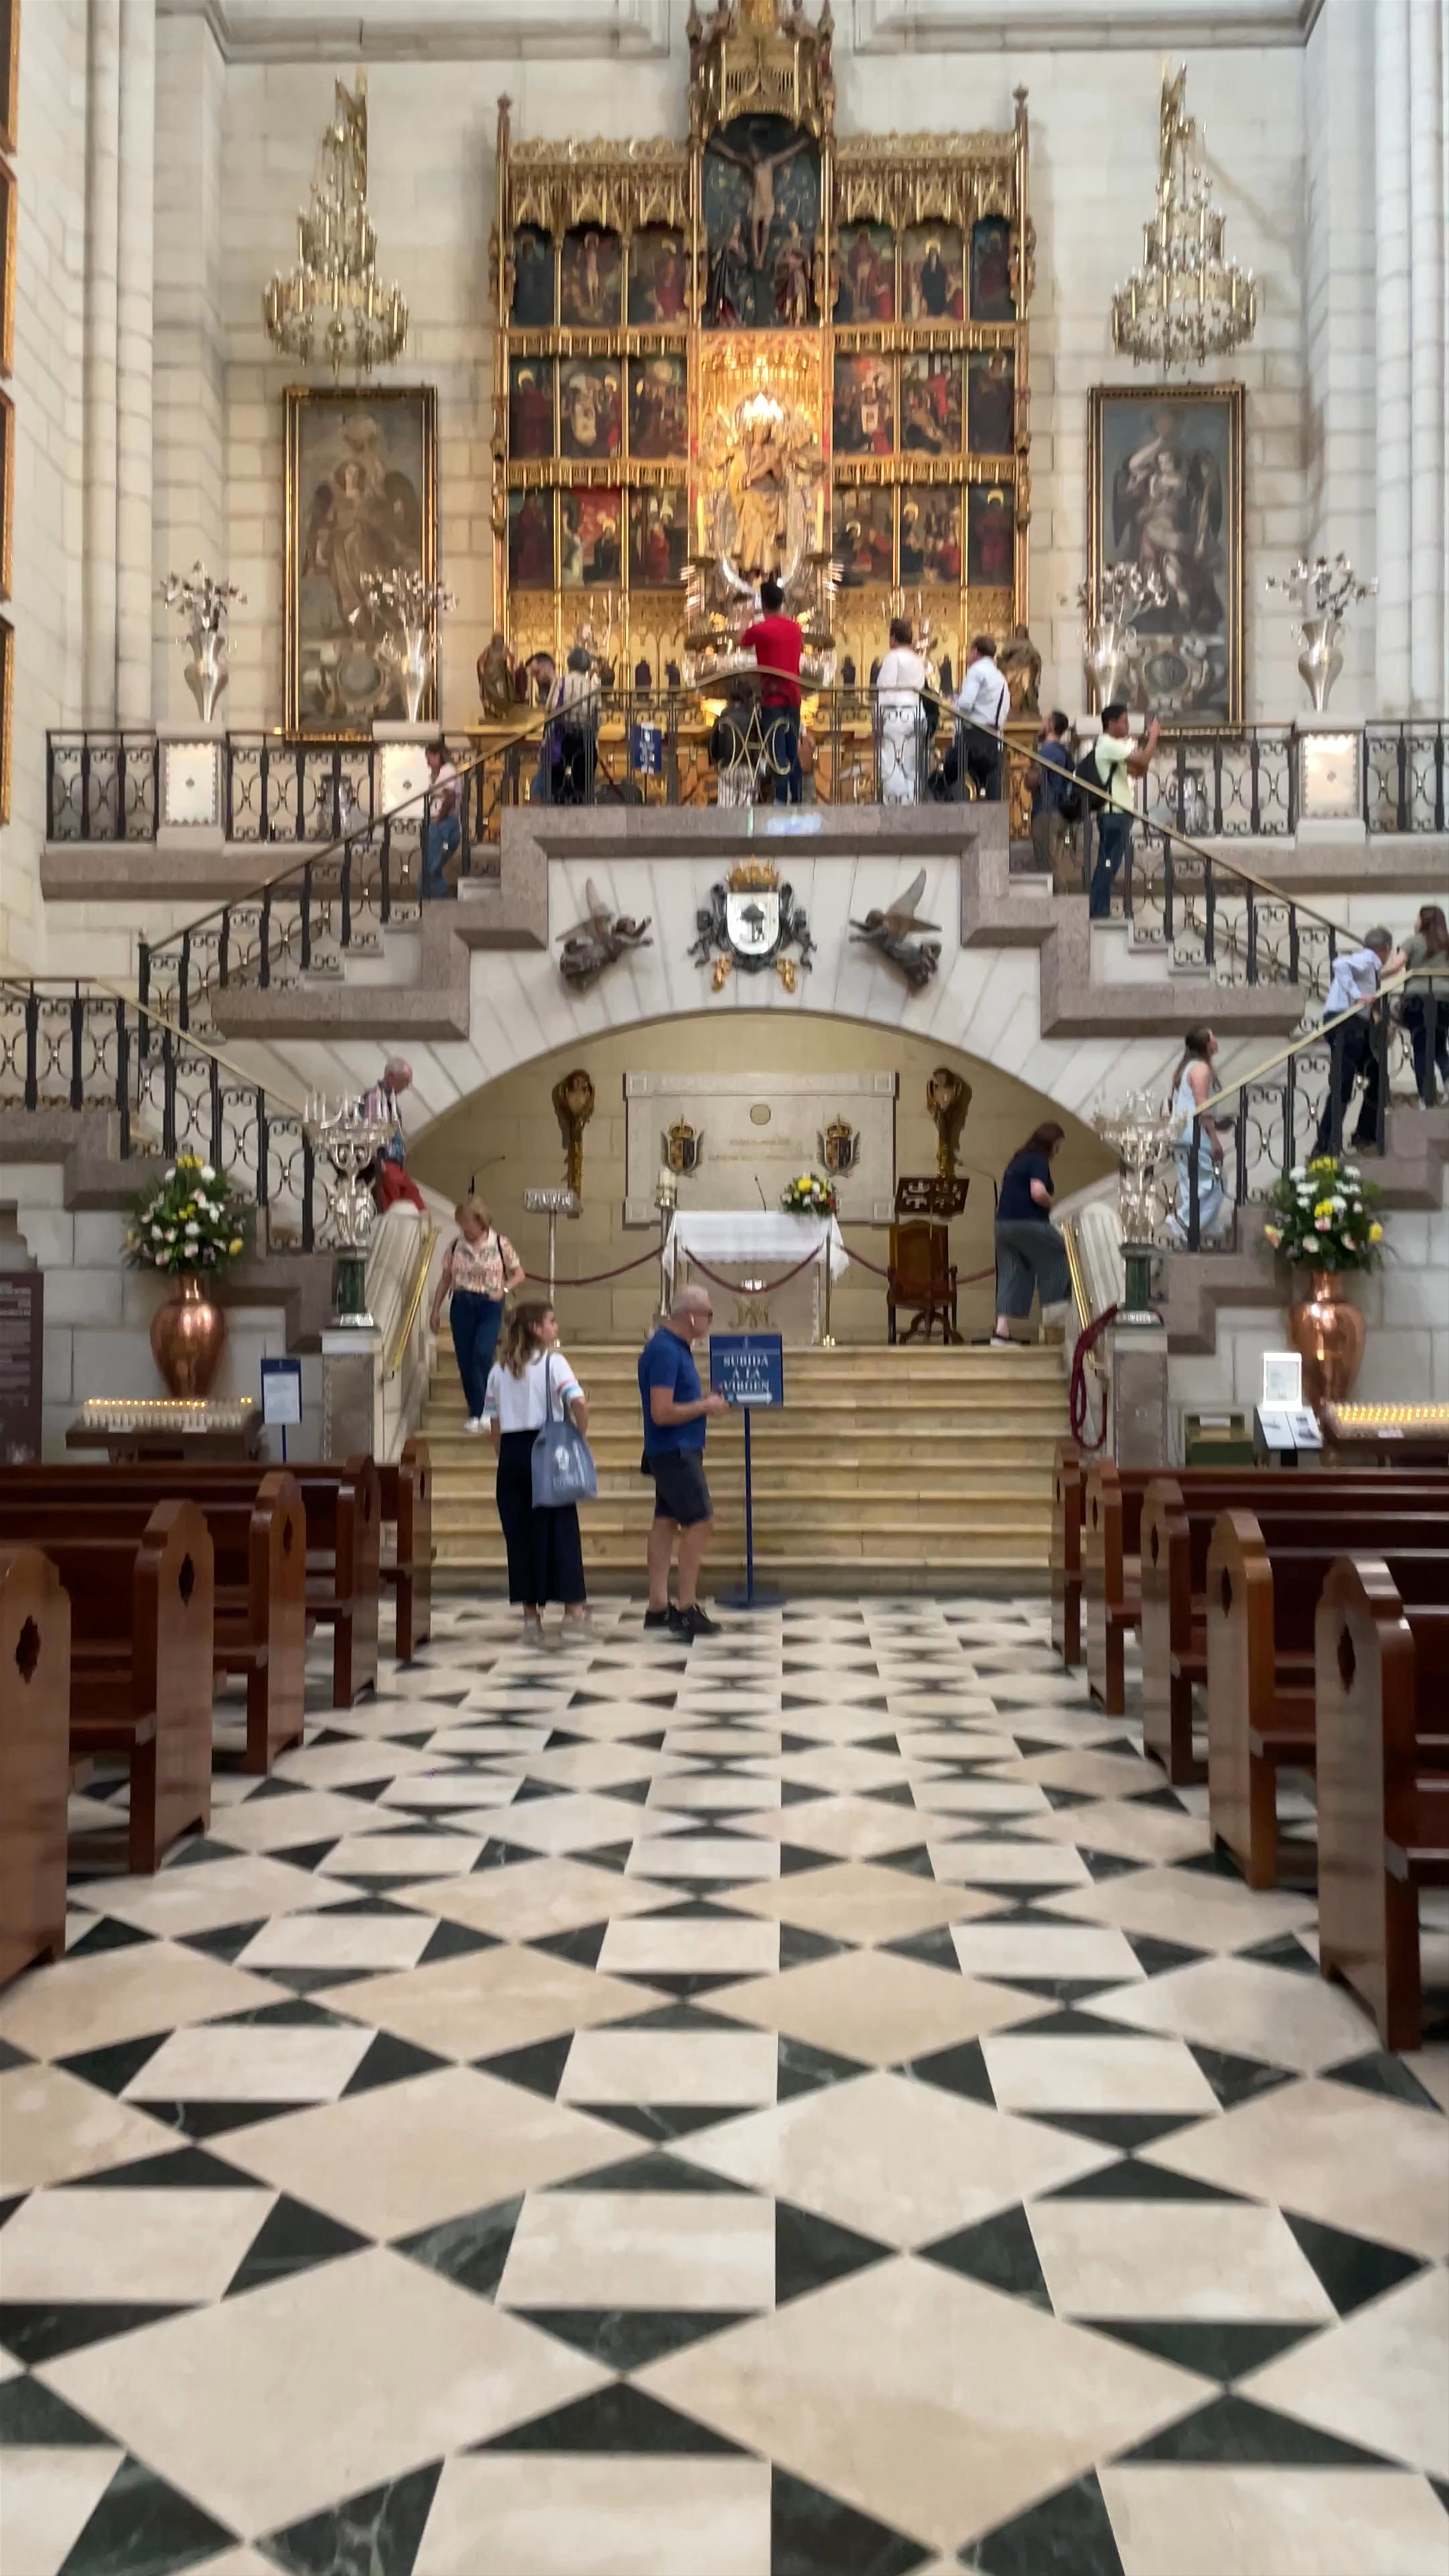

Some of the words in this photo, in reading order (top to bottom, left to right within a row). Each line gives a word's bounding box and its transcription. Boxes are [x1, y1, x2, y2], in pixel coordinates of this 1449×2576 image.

[723, 1355, 768, 1367] SUBIDA
[732, 1367, 740, 1380] A
[746, 1367, 760, 1380] LA
[724, 1380, 769, 1391] VIRGEN
